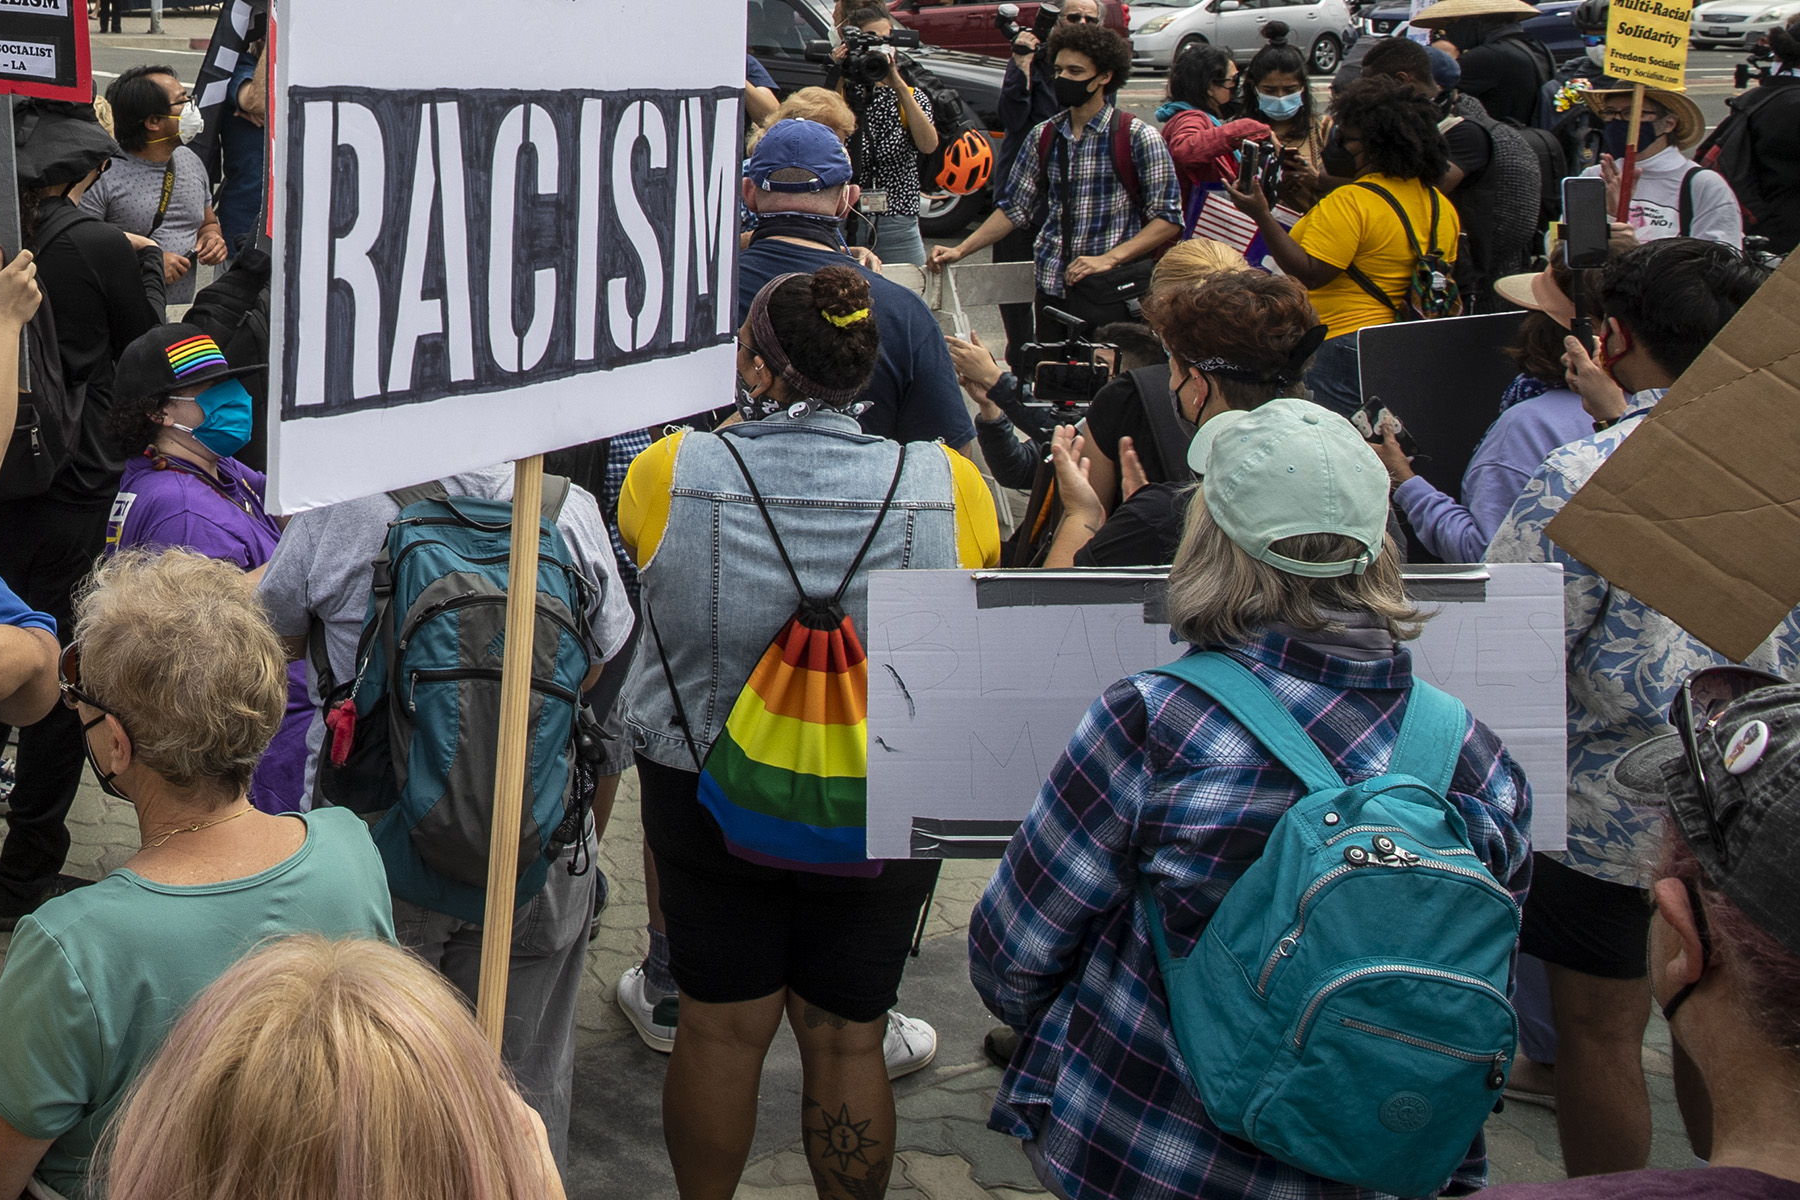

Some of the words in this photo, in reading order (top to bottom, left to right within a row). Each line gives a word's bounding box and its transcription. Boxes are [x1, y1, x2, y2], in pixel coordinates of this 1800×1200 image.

[1616, 21, 1682, 49] Solidarity
[11, 60, 27, 71] LA
[1609, 48, 1647, 65] Freedom
[1648, 56, 1681, 71] Socialist
[1609, 62, 1632, 77] Party
[1634, 68, 1679, 85] Socialism.com
[1650, 219, 1673, 229] NO!
[294, 97, 740, 407] RACISM
[878, 606, 1157, 698] BLAC
[1417, 611, 1559, 689] VES
